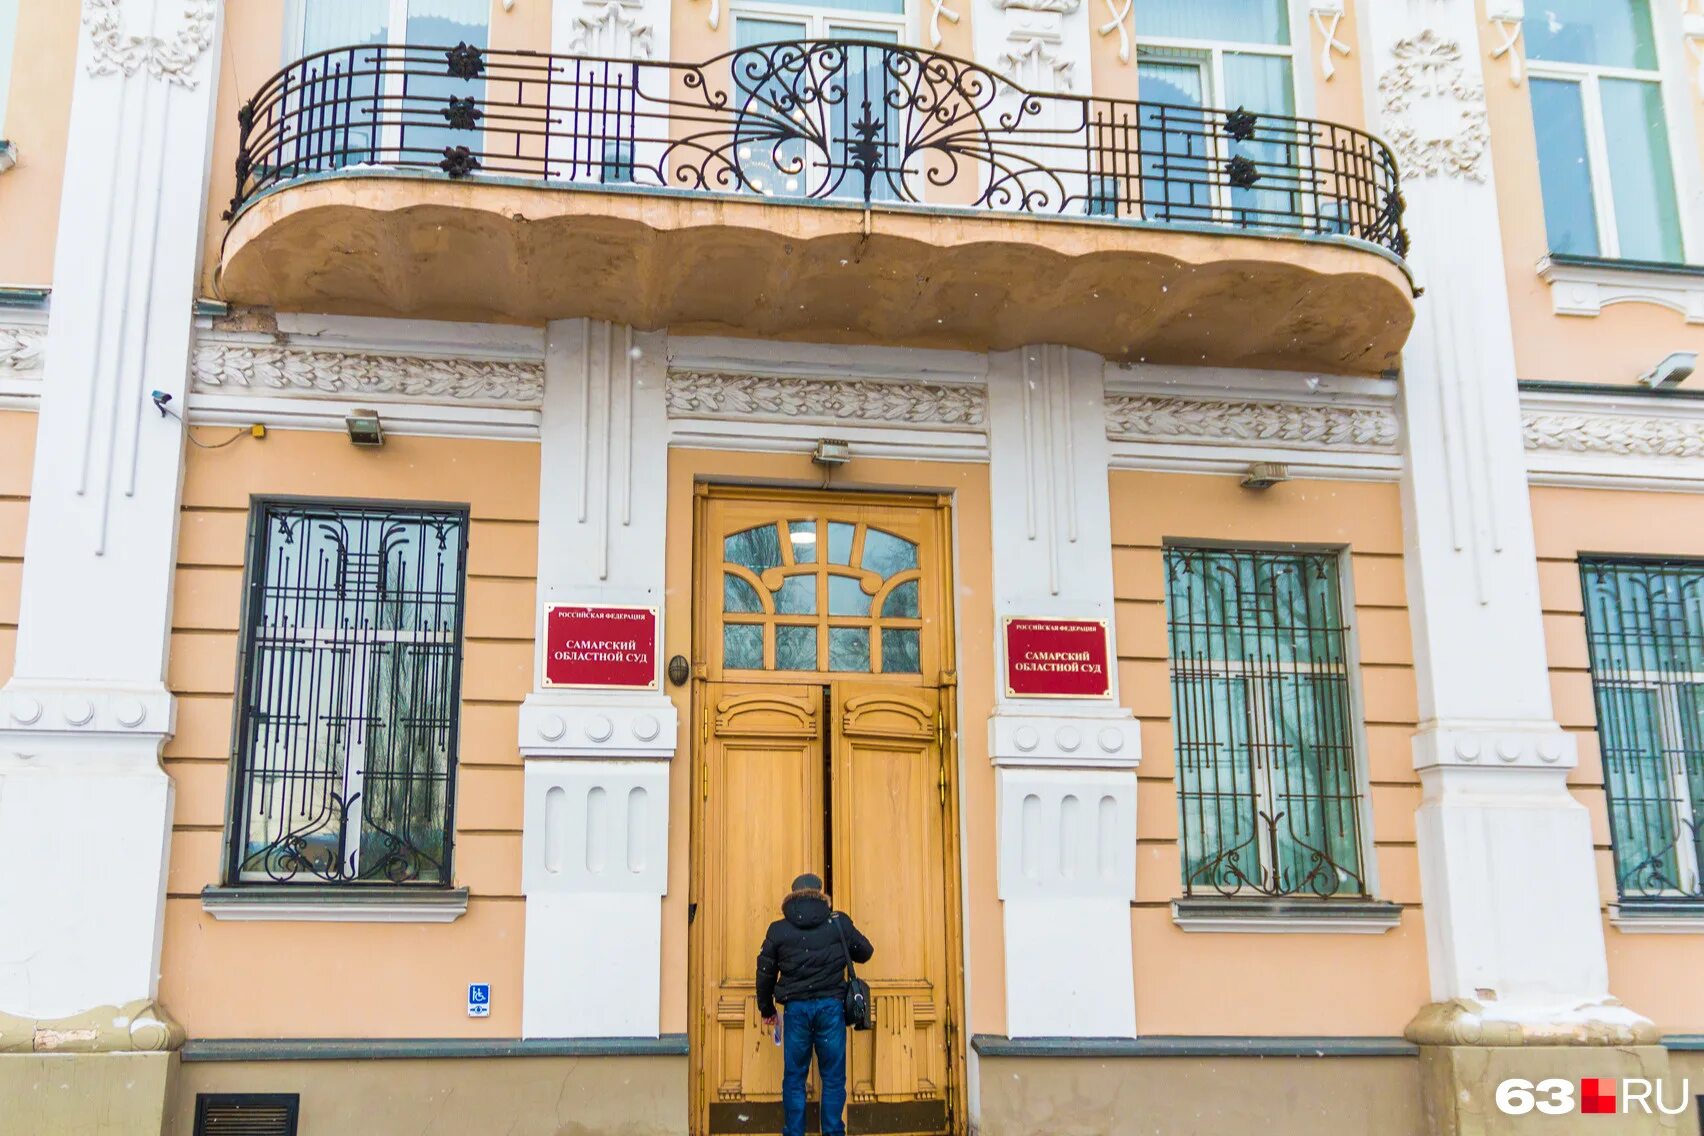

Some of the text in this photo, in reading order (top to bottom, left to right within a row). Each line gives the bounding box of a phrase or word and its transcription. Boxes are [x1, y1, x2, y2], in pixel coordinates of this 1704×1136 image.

[558, 611, 646, 621] РОССИЙСКАЯ ФЕДЕРАЦИЯ
[1016, 624, 1097, 633] РОССИЙСКАЯ ФЕДЕРАЦИЯ
[566, 640, 636, 651] САМАРСКИЙ
[554, 651, 648, 664] ОБЛАСТНОЙ СУД
[1025, 651, 1090, 661] САМАРСКИЙ
[1015, 662, 1102, 674] ОБЛАСТНОЙ СУД
